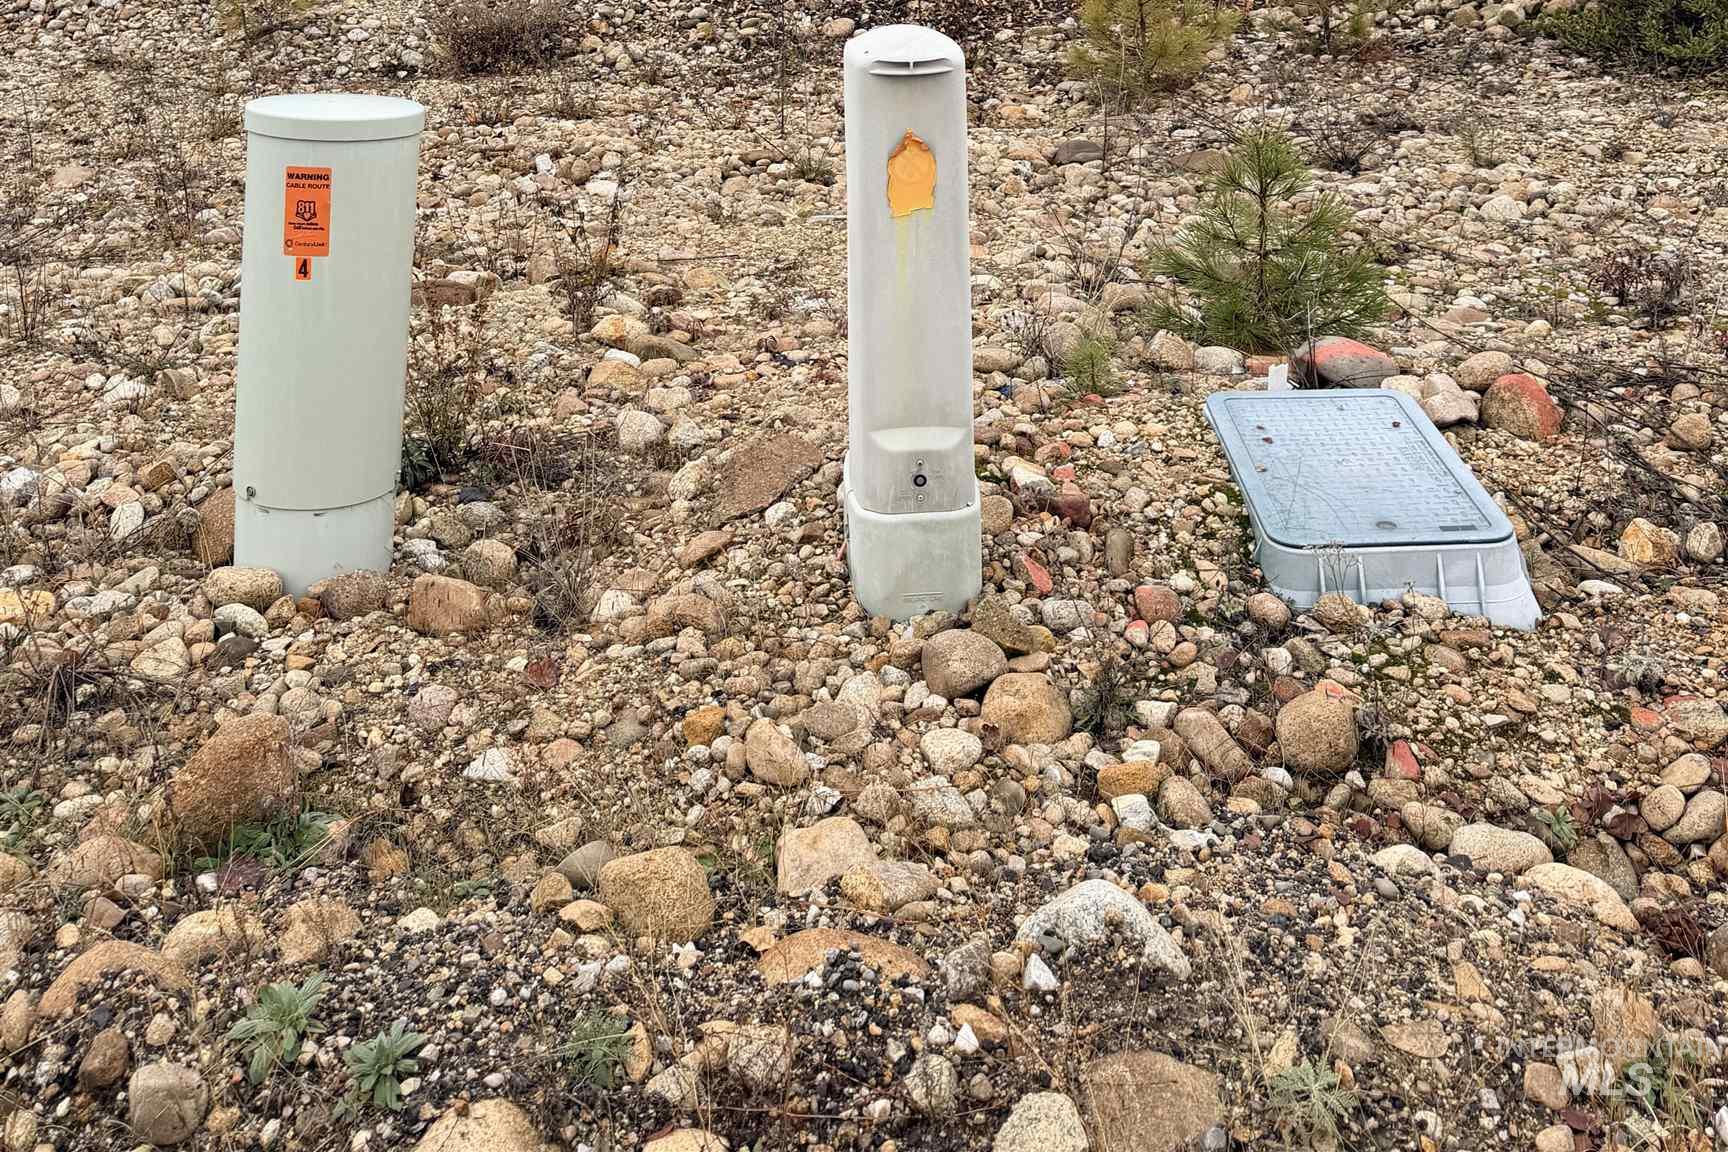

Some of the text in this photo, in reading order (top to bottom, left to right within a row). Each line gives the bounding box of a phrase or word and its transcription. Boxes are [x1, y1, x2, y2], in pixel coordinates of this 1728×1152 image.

[287, 172, 330, 181] WARNING
[298, 201, 315, 214] 811
[298, 258, 309, 279] 4
